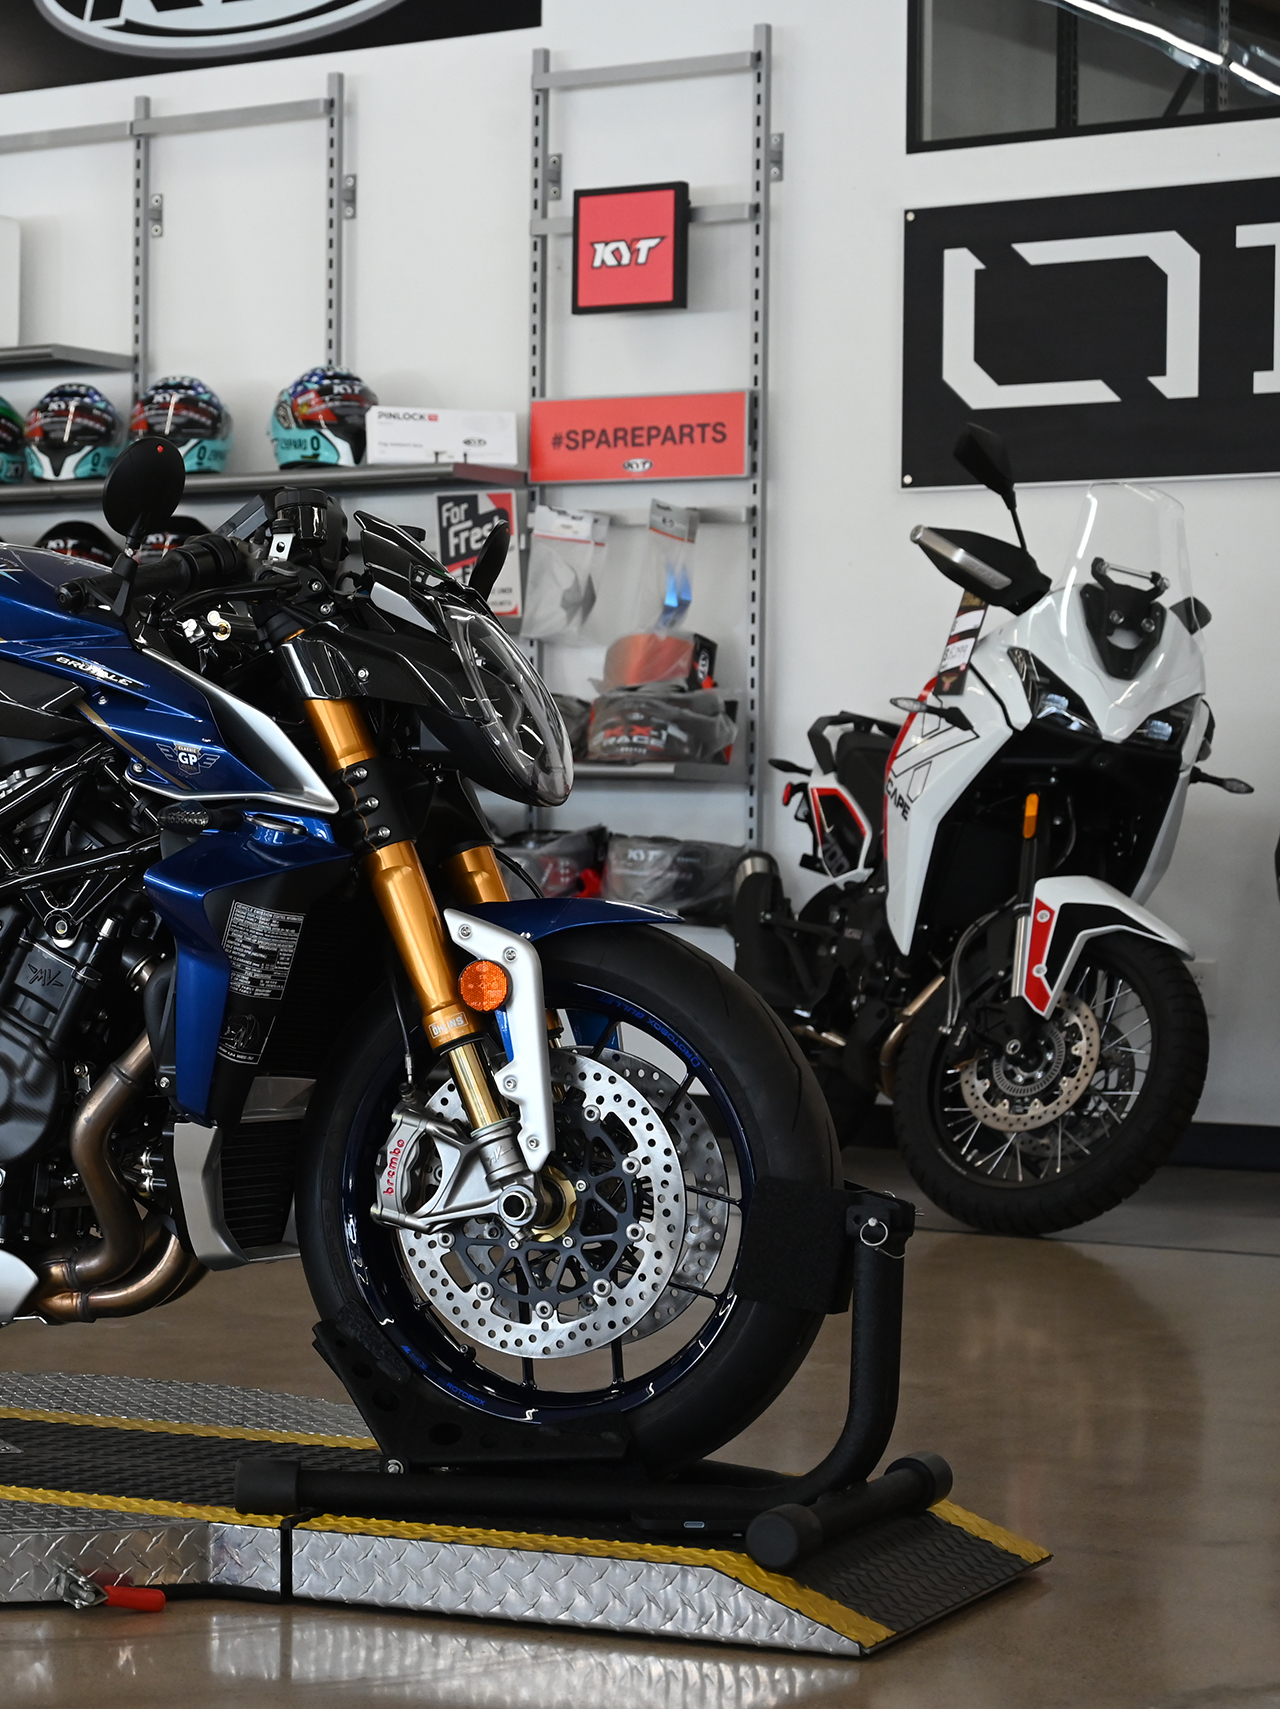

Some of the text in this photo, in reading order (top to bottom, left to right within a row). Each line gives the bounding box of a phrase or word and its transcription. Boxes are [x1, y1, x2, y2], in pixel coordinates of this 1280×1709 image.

[591, 236, 667, 269] KYT
[551, 422, 727, 451] #SPAREPARTS
[441, 502, 469, 528] For
[178, 752, 198, 765] GP
[885, 778, 911, 821] CAPE
[626, 849, 657, 862] KYT
[431, 1015, 465, 1036] ÖHLINS
[647, 1018, 693, 1059] ROTOBOX
[383, 1139, 405, 1195] brembo
[445, 1381, 486, 1406] ROTOBOX
